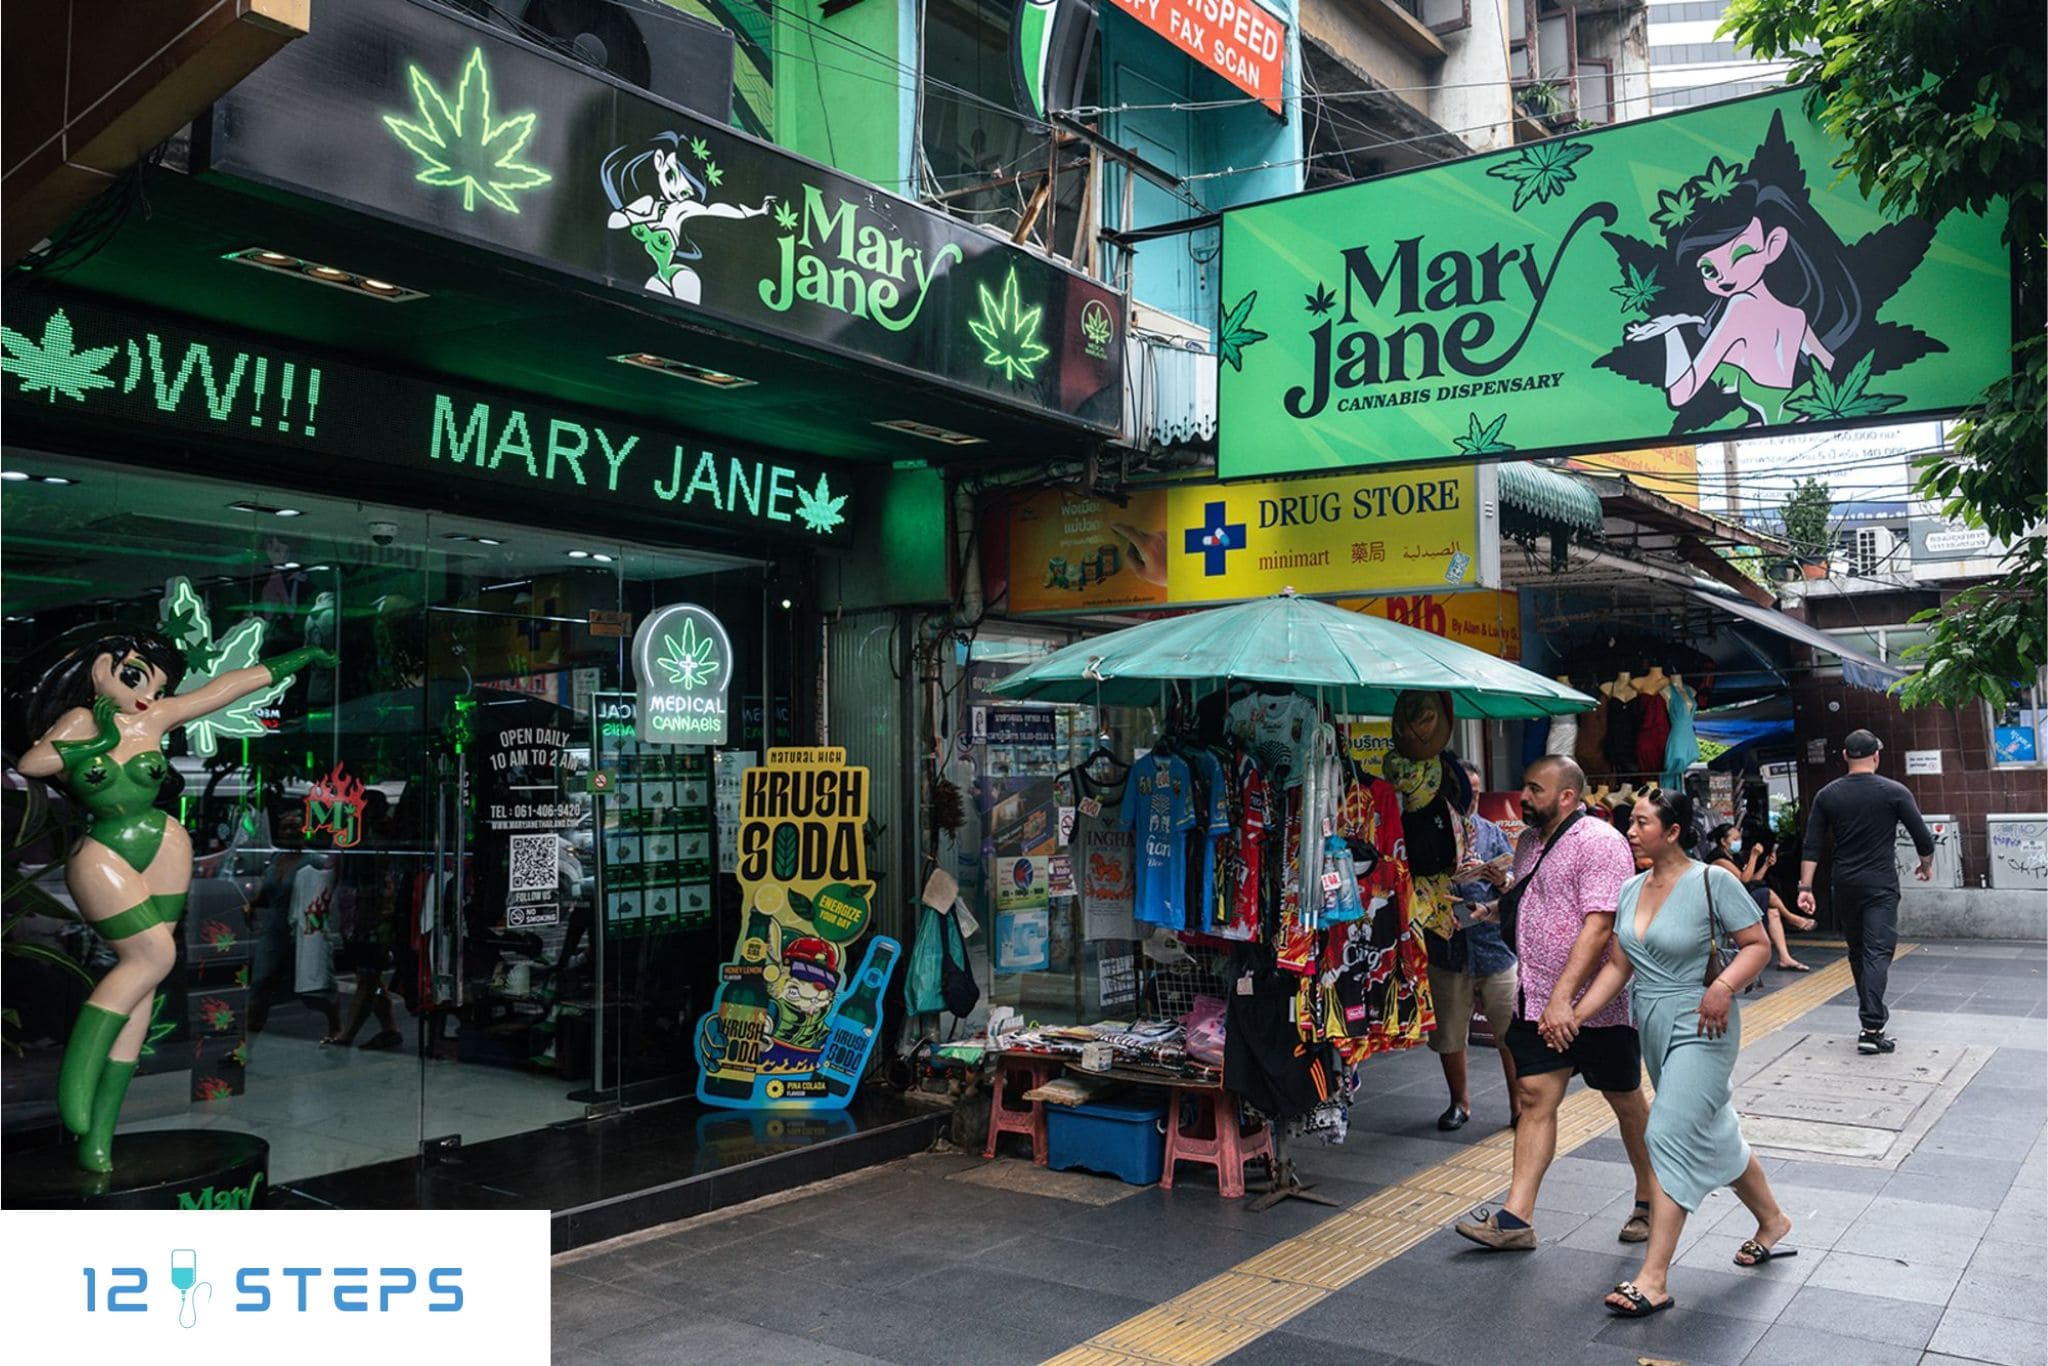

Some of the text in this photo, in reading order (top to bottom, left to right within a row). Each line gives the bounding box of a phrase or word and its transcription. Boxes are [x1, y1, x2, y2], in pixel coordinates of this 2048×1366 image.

[1170, 8, 1205, 53] FAX
[1213, 39, 1260, 89] SCAN
[798, 183, 963, 292] Mary
[1337, 201, 1618, 326] Mary
[1336, 372, 1565, 413] CANNABIS DISPENSARY
[429, 394, 796, 522] MARY JANE
[1258, 479, 1460, 528] DRUG STORE
[1258, 550, 1330, 570] minimart
[1351, 541, 1386, 564] 藥局
[1403, 541, 1461, 562] الصيدلية
[650, 695, 726, 715] MEDICAL
[652, 715, 722, 733] CANNABIS
[500, 728, 570, 748] OPEN DAILY
[490, 749, 579, 771] 10 AM TO 2 AM
[745, 770, 863, 818] KRUSH
[490, 805, 507, 818] TEL
[514, 804, 580, 818] 061-406-9420
[741, 821, 860, 881] SODA
[526, 908, 537, 916] NO
[820, 895, 862, 922] ENERGIZE
[722, 1018, 765, 1042] KRUSH
[832, 1028, 870, 1052] KRUSH
[826, 1043, 863, 1072] SODA
